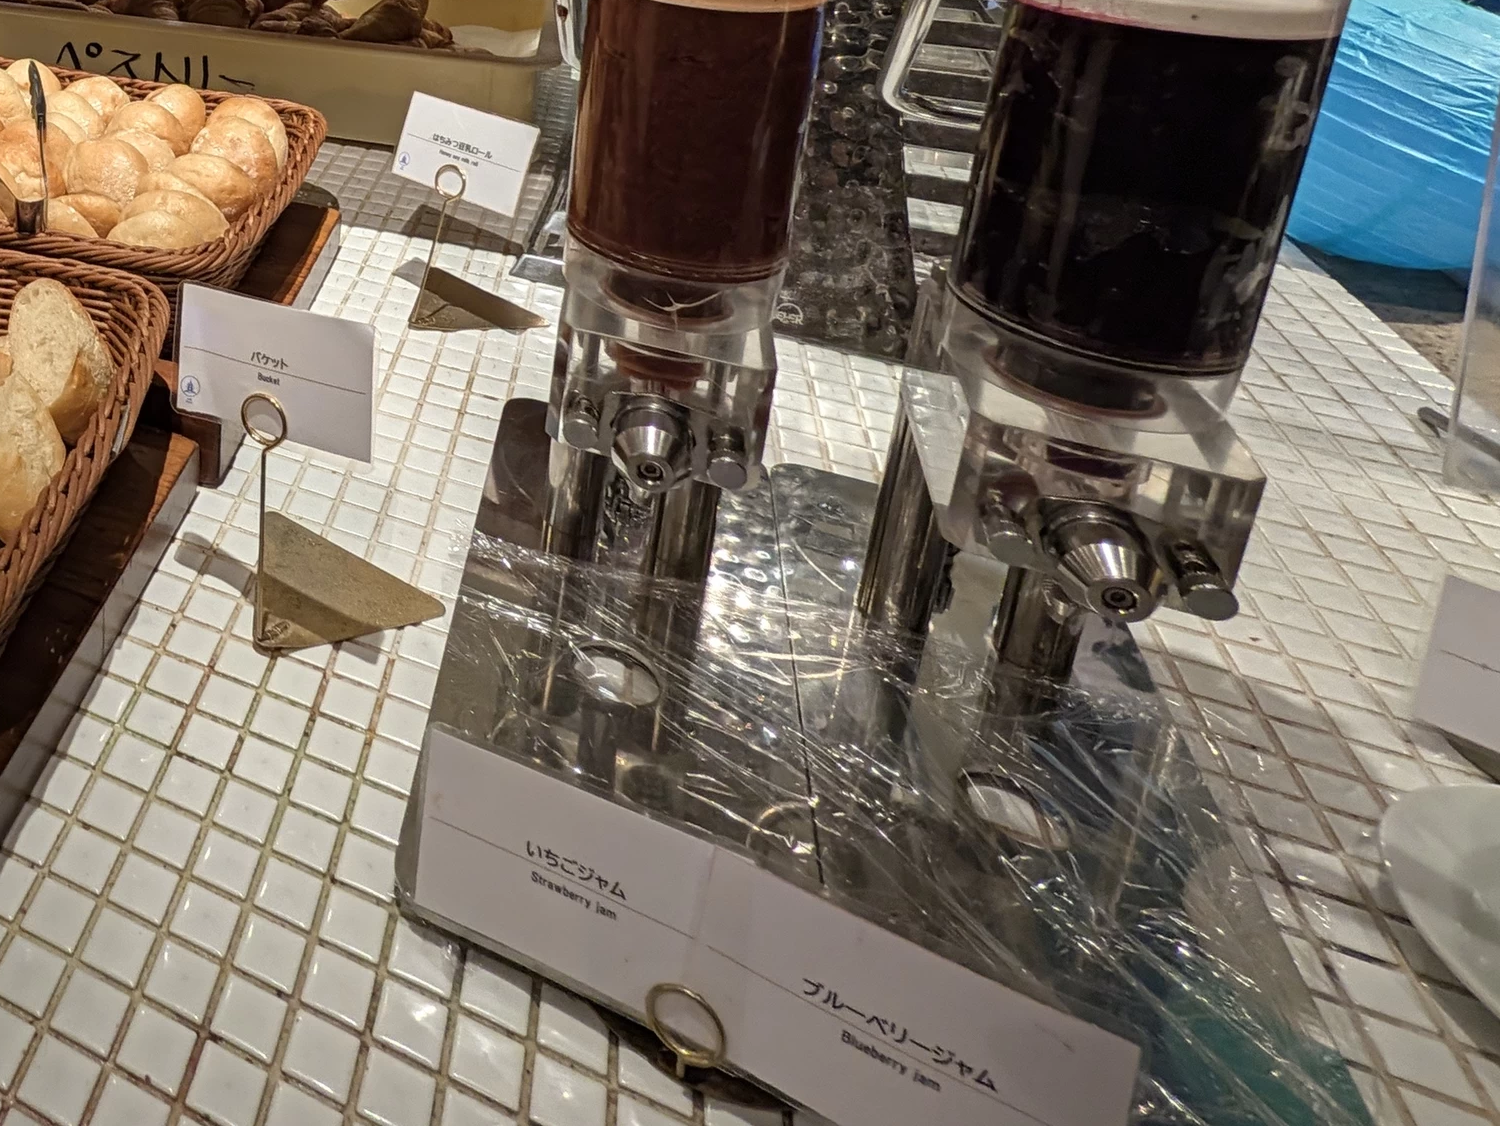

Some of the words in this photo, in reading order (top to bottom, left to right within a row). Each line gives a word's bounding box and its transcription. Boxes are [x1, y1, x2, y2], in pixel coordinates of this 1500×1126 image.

[56, 41, 255, 90] ペストリー
[257, 372, 280, 385] Bucket
[526, 840, 626, 900] いちごジャム
[531, 871, 591, 909] Strawberry
[595, 901, 617, 921] jam
[802, 977, 998, 1094] ブルーベリージャム
[841, 1029, 908, 1076] Blueberry
[913, 1070, 942, 1093] jam
